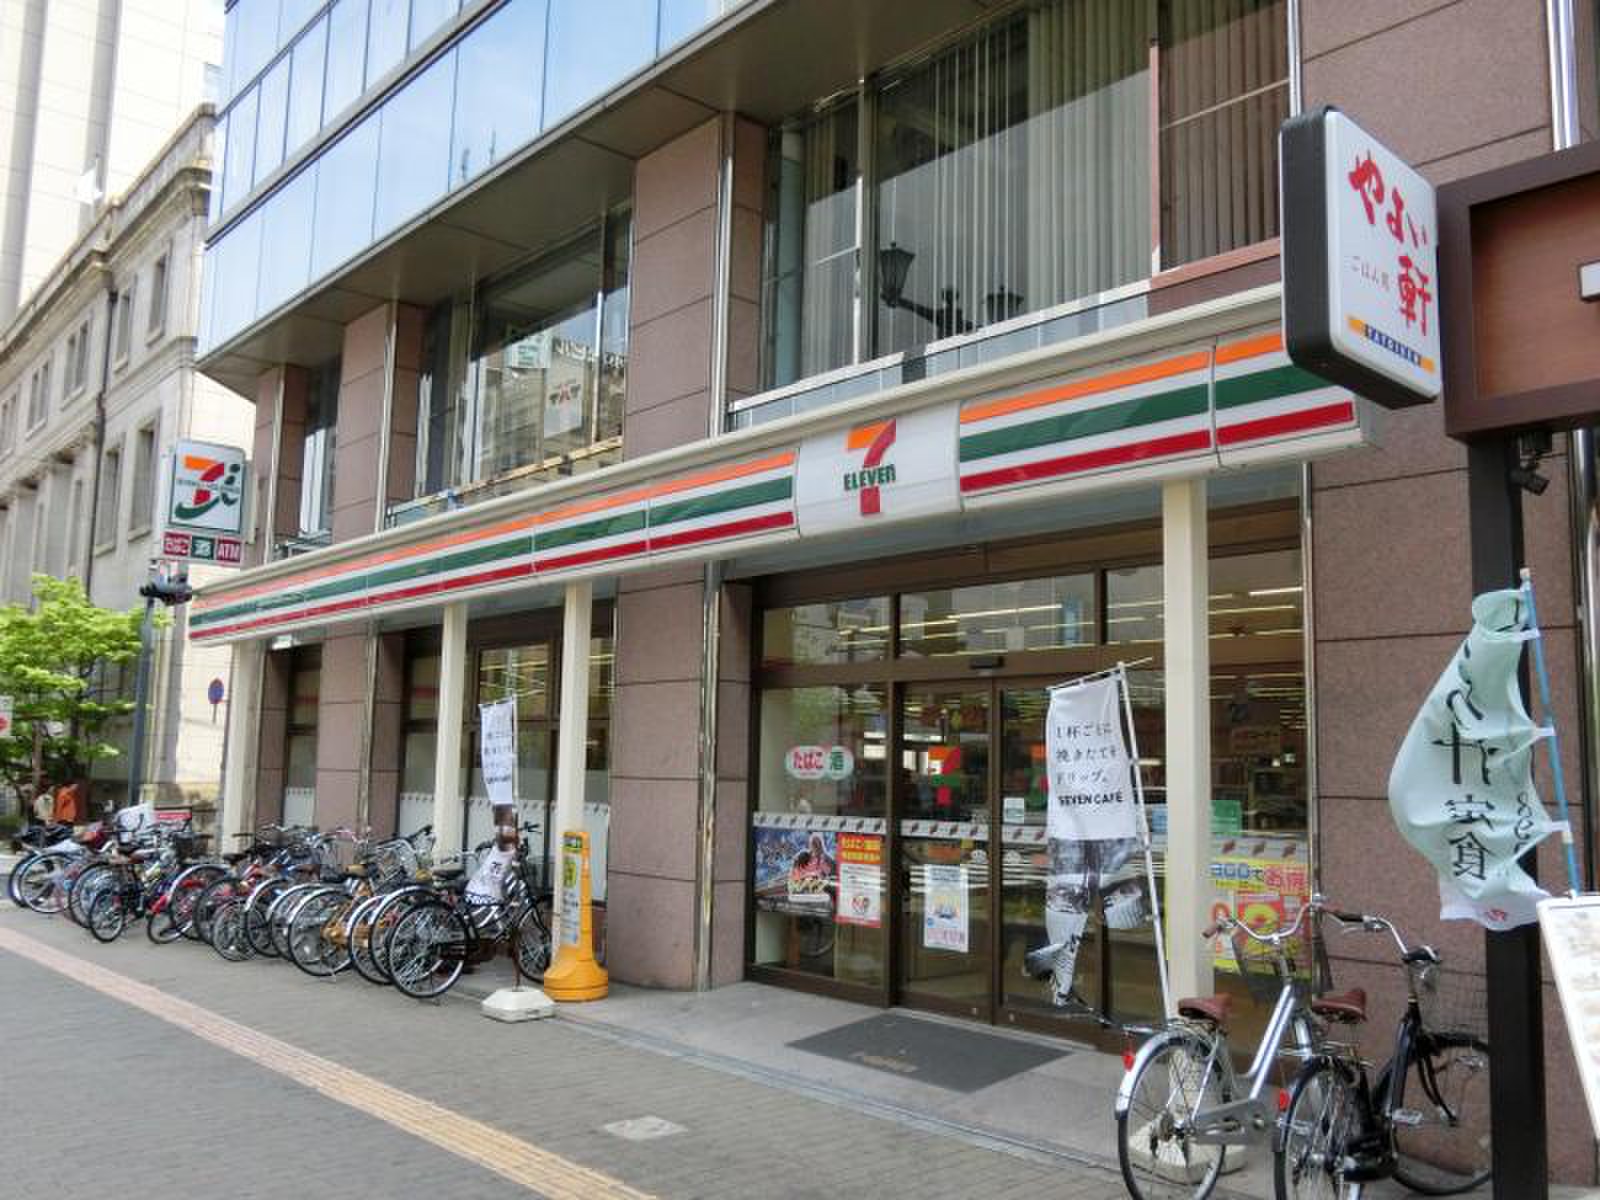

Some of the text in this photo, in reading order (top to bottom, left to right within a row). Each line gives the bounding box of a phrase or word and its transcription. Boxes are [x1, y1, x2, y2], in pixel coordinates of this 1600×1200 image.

[845, 418, 897, 517] 7
[217, 541, 241, 559] ATM
[793, 751, 824, 769] たばこ
